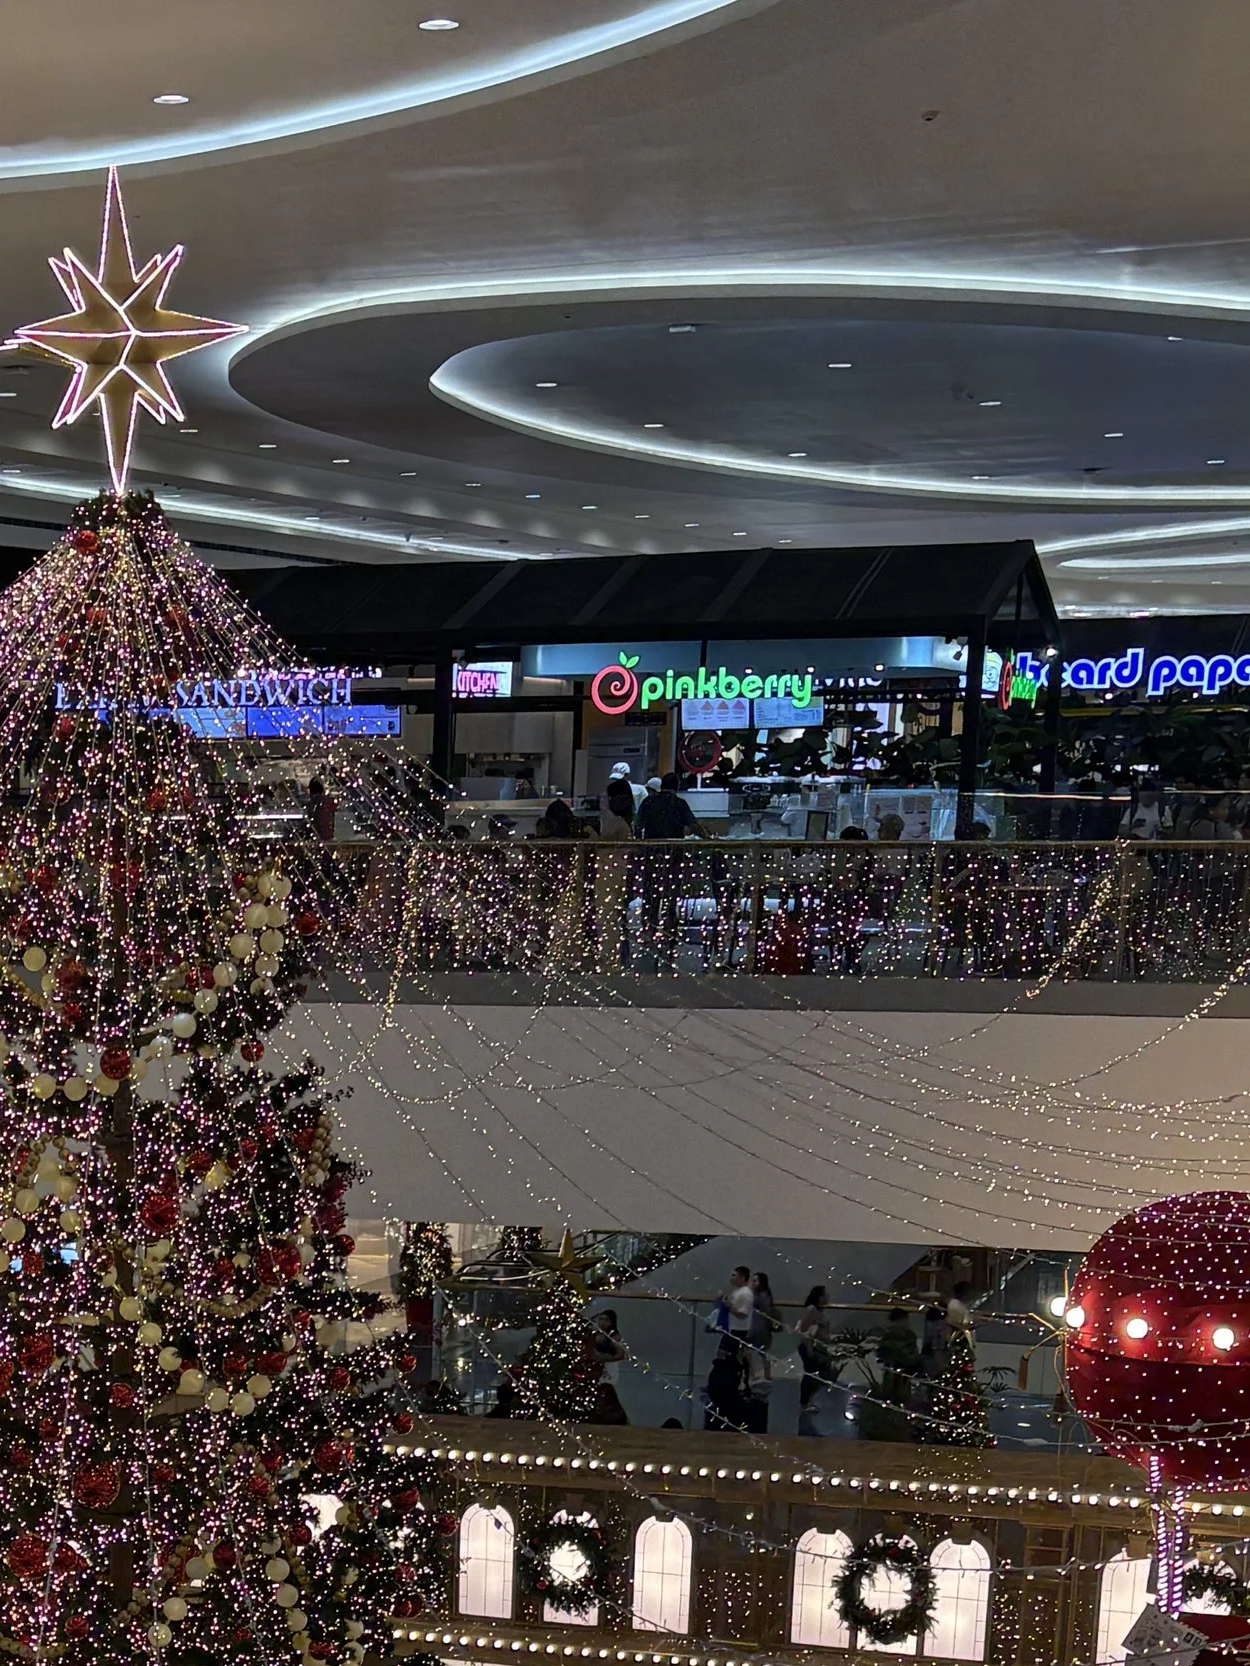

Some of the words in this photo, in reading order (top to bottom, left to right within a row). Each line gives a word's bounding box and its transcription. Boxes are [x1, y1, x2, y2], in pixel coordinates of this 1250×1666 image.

[176, 677, 352, 707] SANDWICH
[457, 671, 499, 693] KITCHEN
[641, 667, 812, 709] pinkberry
